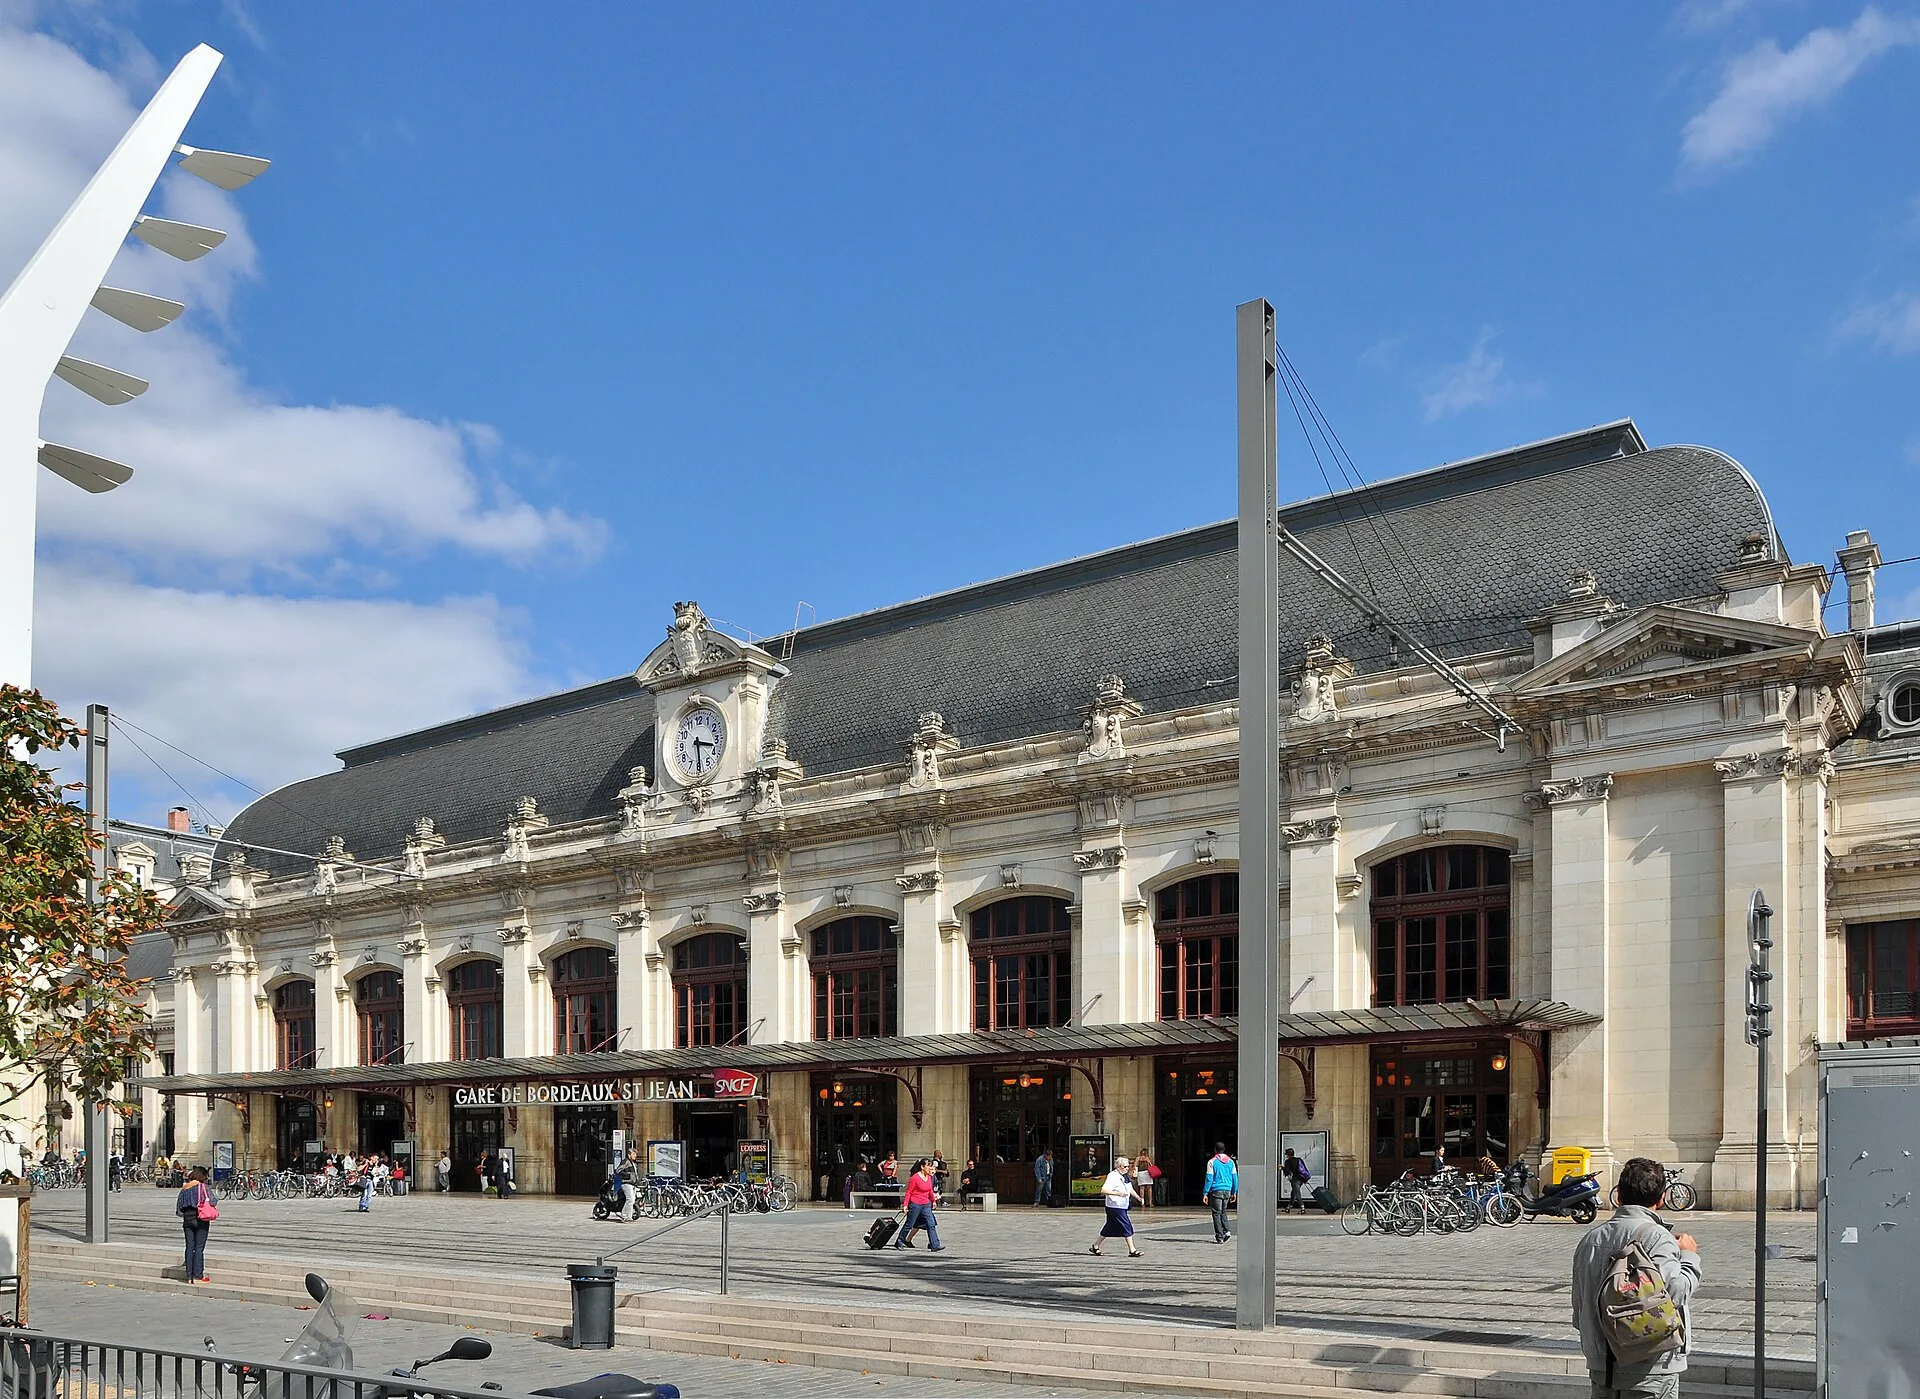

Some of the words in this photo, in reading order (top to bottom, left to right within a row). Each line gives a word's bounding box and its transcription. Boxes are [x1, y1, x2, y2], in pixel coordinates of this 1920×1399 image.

[687, 720, 693, 730] 11
[695, 716, 703, 725] 12
[711, 723, 717, 732] 2
[680, 730, 688, 740] 10
[714, 735, 719, 744] 3
[680, 743, 684, 751] 9
[712, 746, 716, 755] 4
[681, 754, 687, 763] 8
[705, 757, 711, 766] 5
[688, 761, 693, 770] 7
[715, 1077, 752, 1093] SNCF
[455, 1087, 496, 1105] GARE
[501, 1086, 521, 1103] DE
[527, 1083, 614, 1103] BORDEAUX
[622, 1082, 642, 1100] ST
[647, 1080, 694, 1100] JEAN
